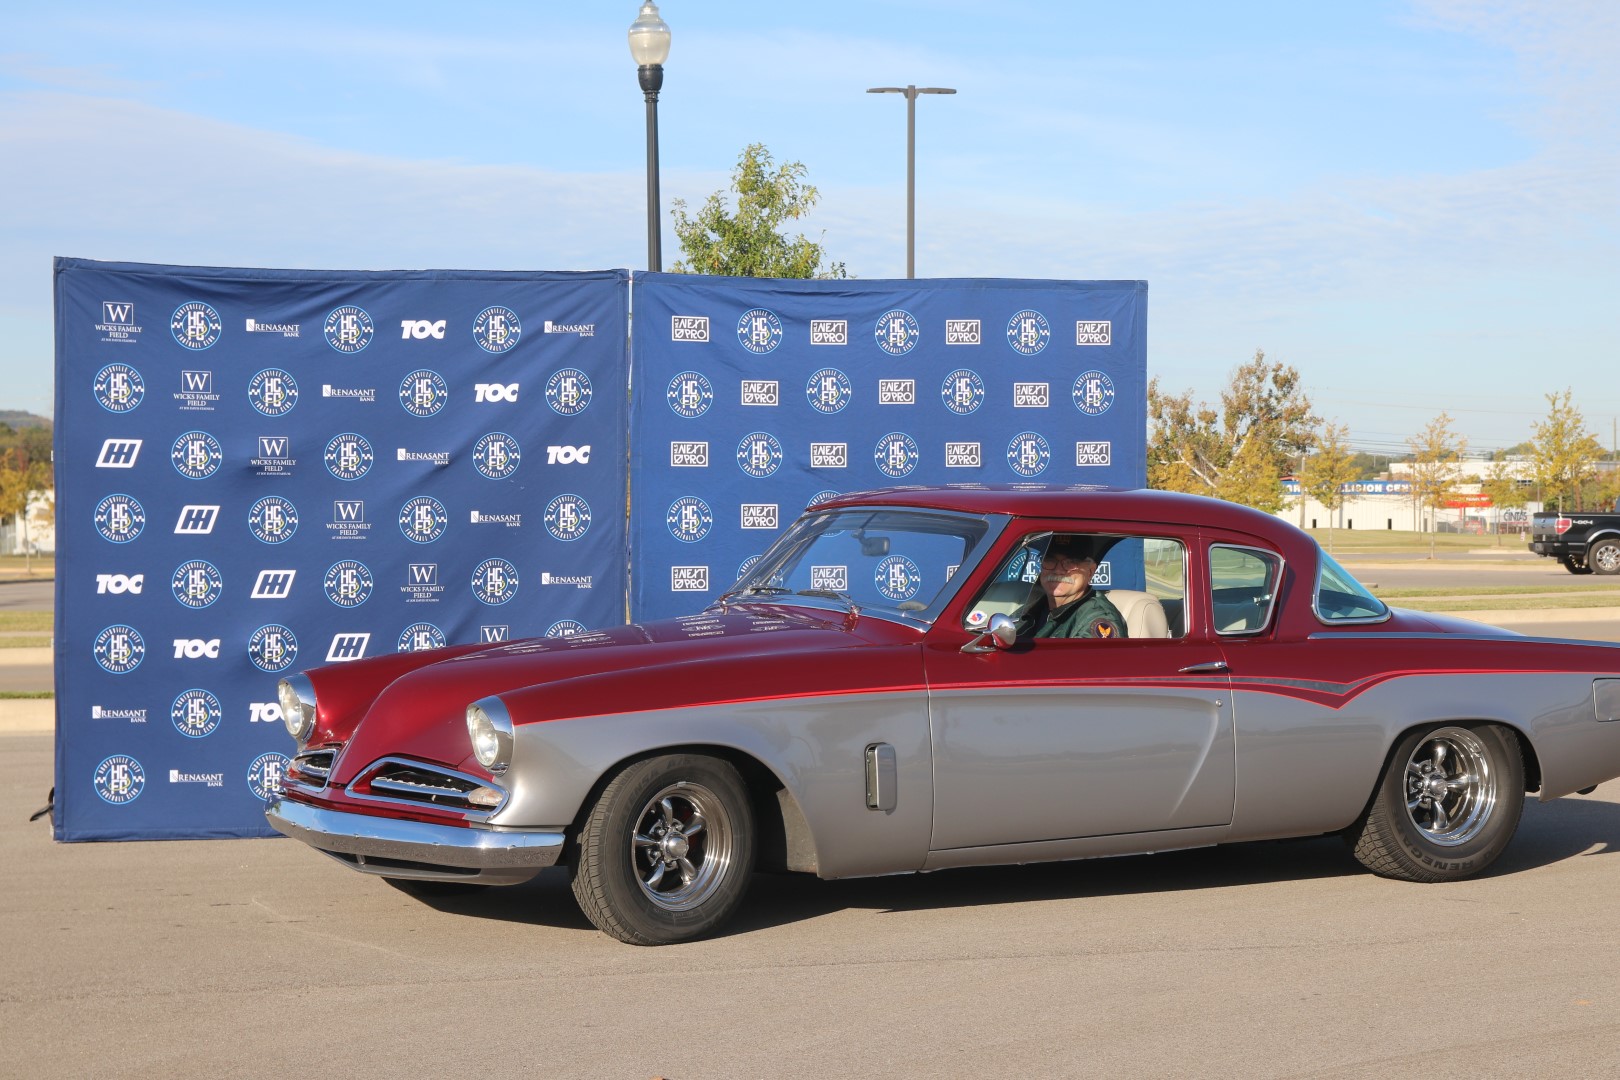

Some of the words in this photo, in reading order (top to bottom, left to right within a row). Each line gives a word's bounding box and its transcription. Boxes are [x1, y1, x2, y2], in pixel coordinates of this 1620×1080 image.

[106, 304, 131, 323] W
[188, 311, 204, 325] HC
[95, 324, 118, 332] WICKS
[255, 324, 299, 332] RENASANT
[341, 314, 357, 329] HC
[489, 315, 505, 329] HC
[678, 318, 706, 328] NEXT
[752, 317, 767, 331] HC
[816, 323, 844, 332] NEXT
[890, 318, 904, 332] HC
[952, 323, 978, 332] NEXT
[1022, 319, 1035, 332] HC
[1082, 323, 1108, 332] NEXT
[188, 326, 204, 341] FC
[401, 320, 446, 339] TOC
[686, 328, 706, 340] PRO
[341, 330, 357, 344] FC
[489, 330, 505, 344] FC
[752, 332, 767, 345] FC
[824, 332, 844, 343] PRO
[890, 333, 904, 346] FC
[959, 332, 979, 343] PRO
[1022, 333, 1036, 347] FC
[1089, 333, 1109, 343] PRO
[111, 373, 127, 388] HC
[185, 373, 209, 391] W
[265, 378, 281, 392] HC
[415, 378, 431, 393] HC
[561, 378, 576, 392] HC
[683, 380, 697, 394] HC
[747, 383, 775, 392] NEXT
[821, 377, 836, 391] HC
[885, 382, 912, 391] NEXT
[956, 378, 970, 392] HC
[1086, 379, 1100, 393] HC
[111, 389, 127, 404] FC
[474, 383, 519, 402] TOC
[1020, 385, 1046, 394] NEXT
[265, 393, 281, 408] FC
[415, 394, 431, 408] FC
[561, 393, 576, 407] FC
[683, 395, 698, 409] FC
[755, 393, 775, 404] PRO
[821, 392, 836, 405] FC
[892, 392, 913, 402] PRO
[956, 393, 970, 406] FC
[1027, 395, 1047, 405] PRO
[1086, 394, 1100, 407] FC
[188, 440, 205, 455] HC
[261, 440, 285, 457] W
[341, 442, 356, 457] HC
[489, 442, 504, 456] HC
[677, 444, 705, 453] NEXT
[753, 441, 767, 455] HC
[816, 446, 844, 455] NEXT
[890, 441, 903, 455] HC
[952, 445, 978, 454] NEXT
[1022, 440, 1035, 454] HC
[1082, 444, 1107, 453] NEXT
[547, 445, 591, 464] TOC
[685, 454, 705, 465] PRO
[824, 456, 844, 466] PRO
[959, 454, 979, 465] PRO
[1022, 455, 1036, 468] FC
[1089, 454, 1108, 464] PRO
[188, 456, 205, 470] FC
[341, 458, 357, 472] FC
[489, 457, 504, 471] FC
[753, 456, 768, 469] FC
[890, 456, 904, 469] FC
[111, 504, 128, 518] HC
[265, 506, 281, 520] HC
[336, 504, 360, 521] W
[415, 506, 431, 520] HC
[560, 503, 575, 517] HC
[682, 505, 697, 519] HC
[747, 507, 775, 516] NEXT
[480, 515, 521, 523] RENASANT
[560, 518, 575, 532] FC
[755, 516, 775, 527] PRO
[111, 519, 128, 534] FC
[265, 521, 281, 535] FC
[415, 521, 431, 535] FC
[682, 520, 697, 534] FC
[189, 570, 205, 584] HC
[341, 570, 356, 584] HC
[411, 567, 433, 583] W
[487, 567, 502, 581] HC
[677, 569, 705, 578] NEXT
[817, 568, 844, 578] NEXT
[96, 574, 144, 594] TOC
[487, 582, 502, 596] FC
[685, 578, 705, 589] PRO
[824, 578, 845, 590] PRO
[189, 585, 205, 600] FC
[341, 585, 357, 599] FC
[111, 634, 128, 649] HC
[265, 634, 281, 648] HC
[173, 639, 221, 658] TOC
[111, 650, 128, 665] FC
[265, 649, 281, 663] FC
[188, 699, 204, 713] HC
[102, 710, 147, 718] RENASANT
[188, 714, 204, 729] FC
[111, 765, 128, 779] HC
[179, 774, 223, 782] RENASANT
[111, 780, 128, 795] FC
